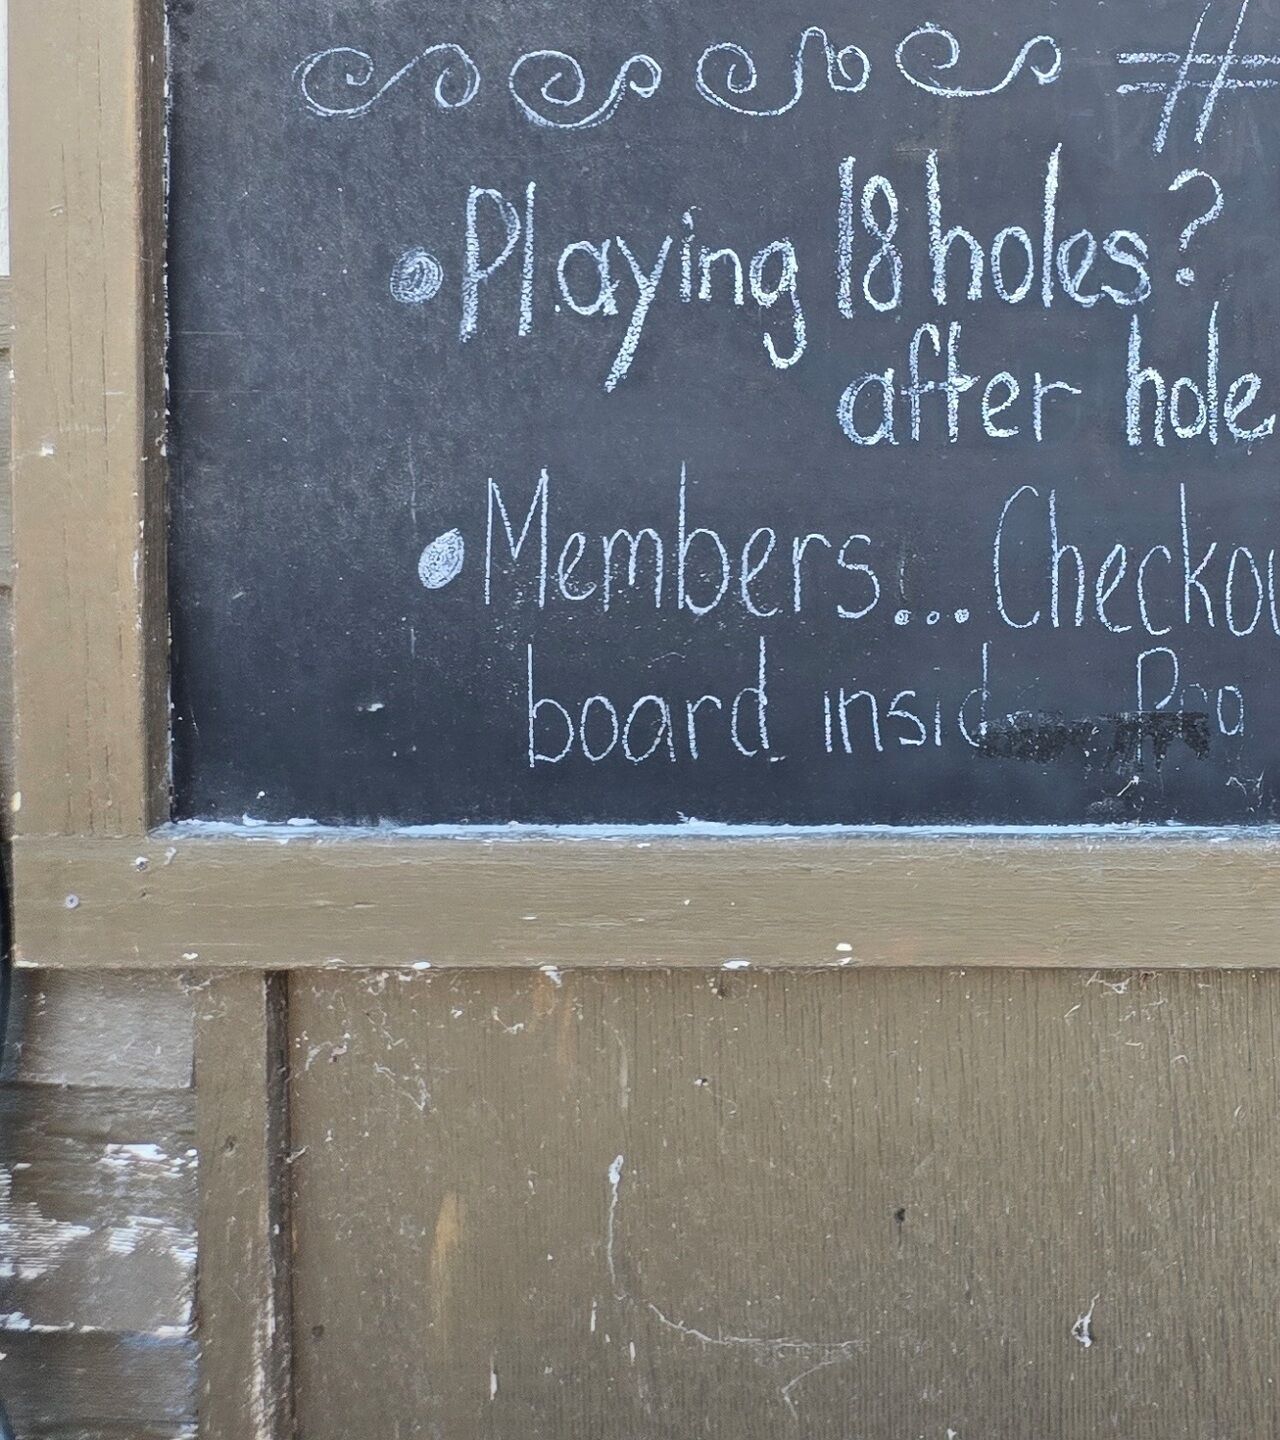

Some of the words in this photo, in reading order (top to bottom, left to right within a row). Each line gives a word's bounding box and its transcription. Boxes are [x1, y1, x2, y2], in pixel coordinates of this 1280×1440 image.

[458, 180, 808, 394] Playing
[836, 320, 1082, 446] after
[1123, 300, 1277, 450] hole
[526, 635, 770, 768] board
[823, 639, 1035, 755] insid
